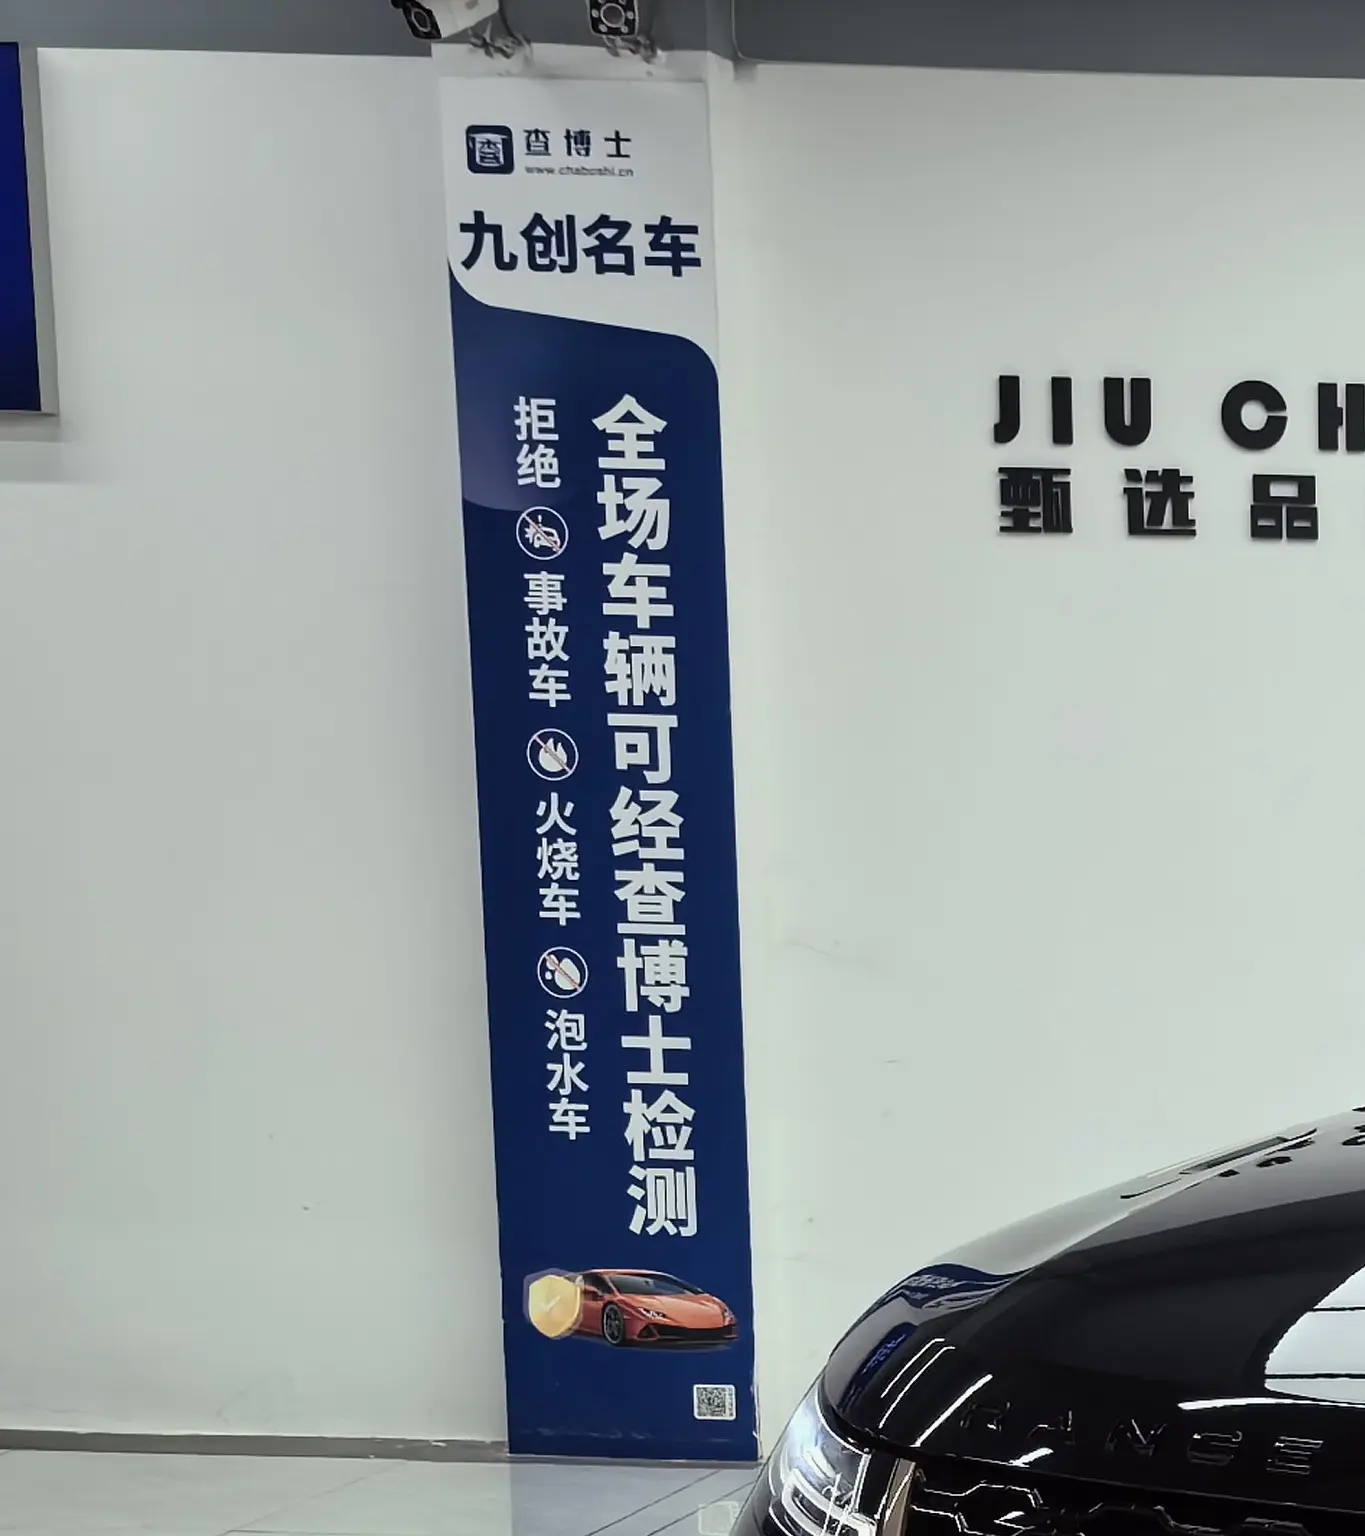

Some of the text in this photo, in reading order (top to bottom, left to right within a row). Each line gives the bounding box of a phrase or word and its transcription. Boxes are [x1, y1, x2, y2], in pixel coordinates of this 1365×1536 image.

[524, 128, 632, 159] 查博士
[459, 210, 702, 278] 九创名车
[993, 374, 1152, 446] JIU
[513, 396, 590, 1140] 拒绝 事故车 火烧车 泡水车
[591, 393, 698, 1237] 全场车辆可经查博士检测
[960, 1401, 1324, 1475] RANGE
